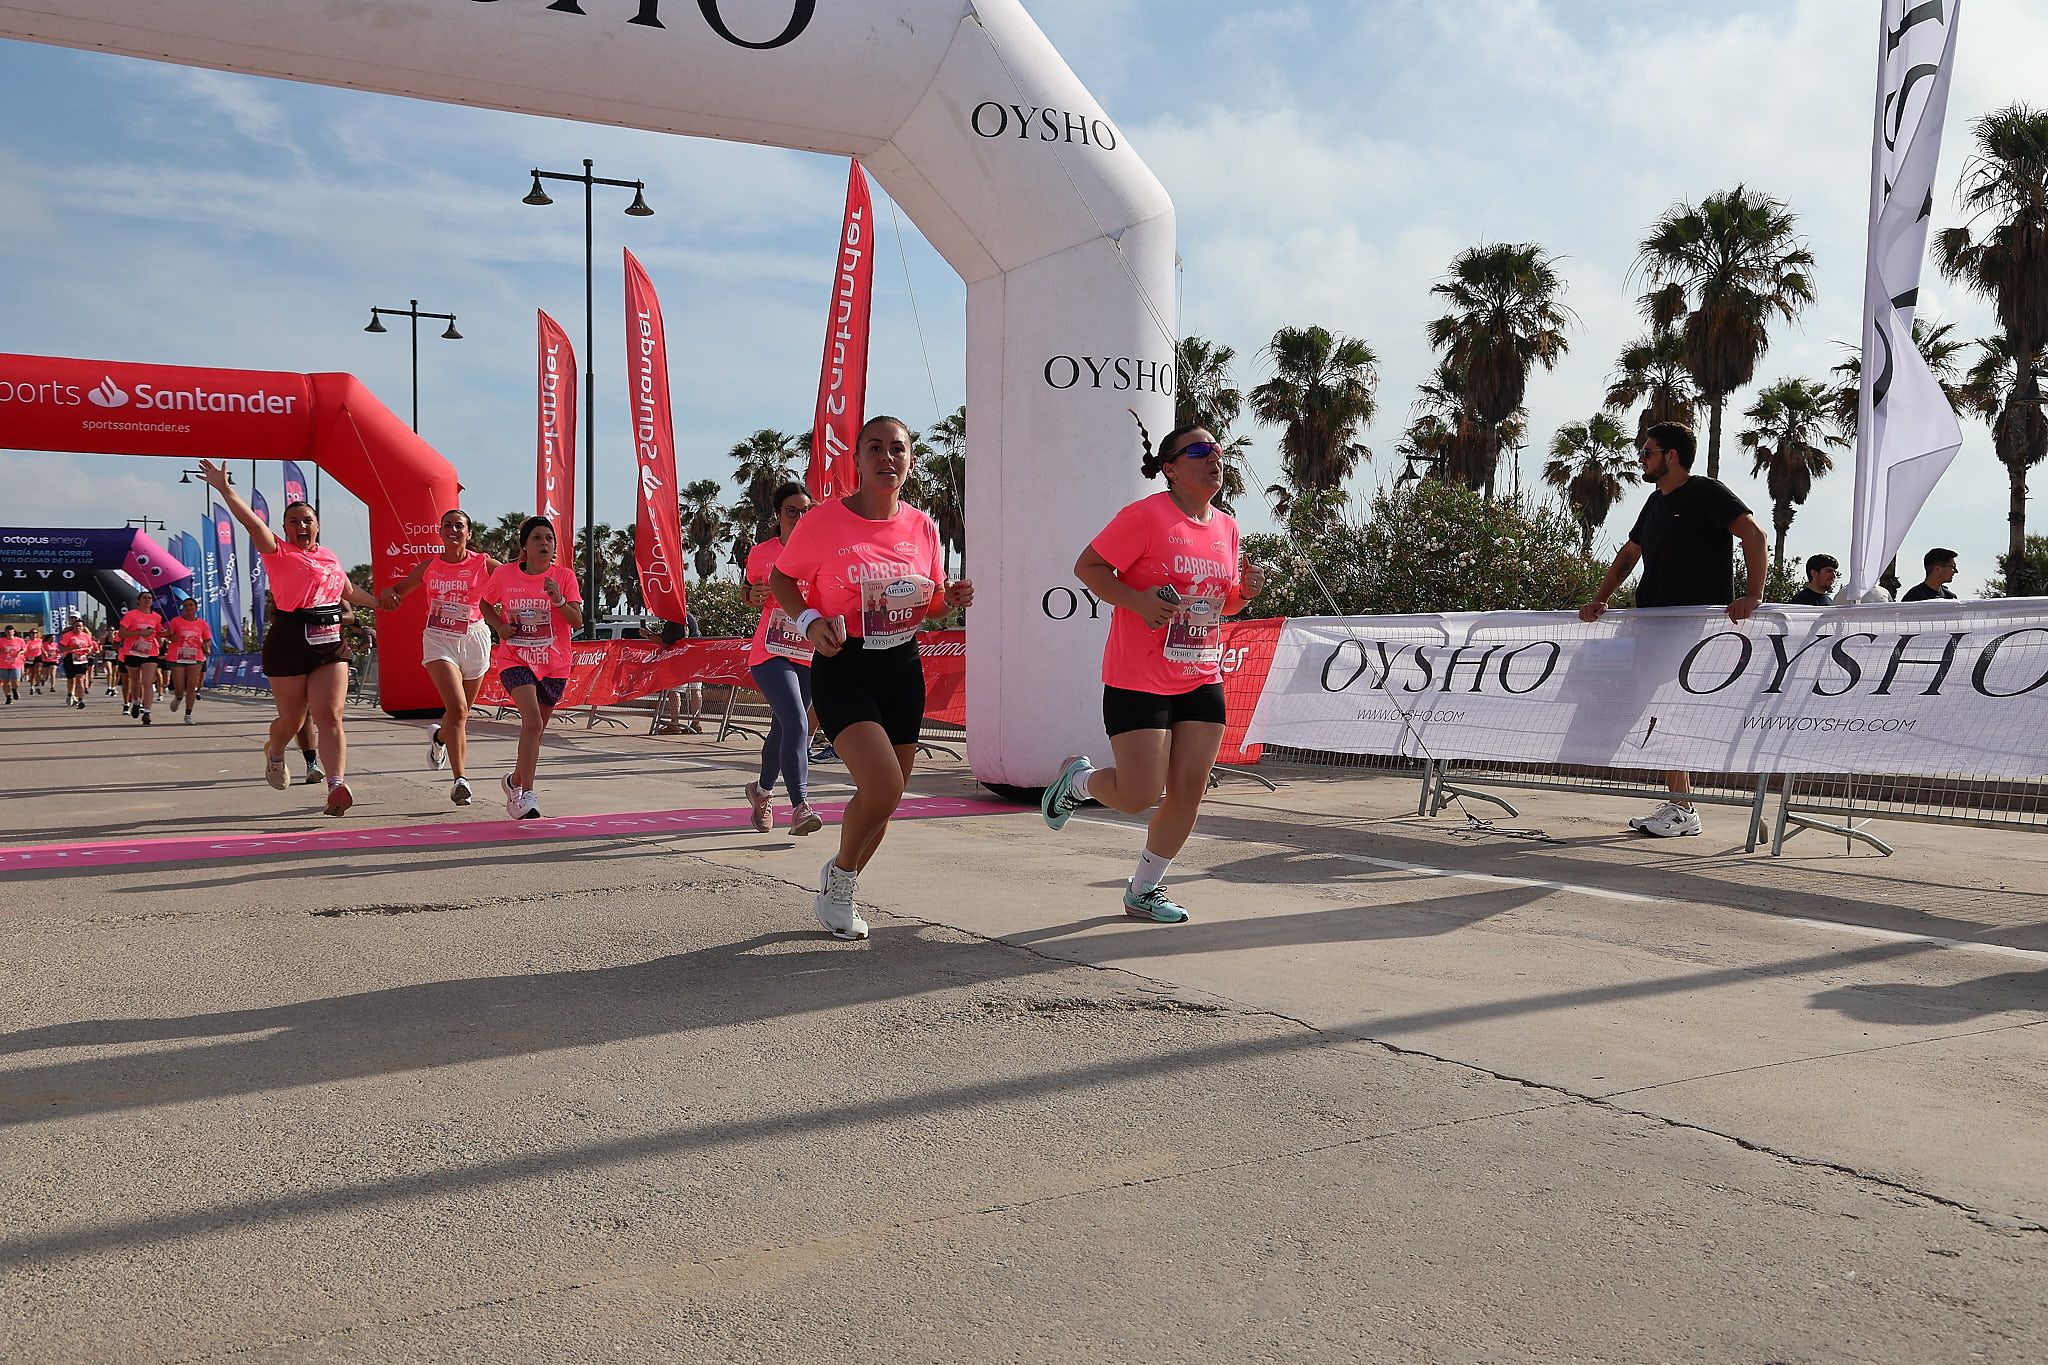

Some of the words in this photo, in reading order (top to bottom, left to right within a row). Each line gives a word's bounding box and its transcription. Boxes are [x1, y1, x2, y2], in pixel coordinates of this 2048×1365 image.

[970, 101, 1117, 151] OYSHO
[1043, 354, 1173, 398] OYSHO
[135, 383, 297, 415] Santander
[82, 419, 191, 433] sportssantander.es
[838, 545, 871, 556] OYSHO
[0, 569, 75, 579] LVO
[847, 562, 917, 584] CARRERA
[1174, 555, 1229, 580] CARRERA
[430, 579, 468, 591] CARRERA
[509, 599, 552, 611] CARRERA
[441, 617, 456, 625] 016
[889, 608, 912, 622] 016
[783, 631, 802, 642] 016
[1188, 625, 1208, 637] 016
[1321, 639, 1561, 694] OYSHO
[1678, 627, 2048, 698] OYSHO
[1356, 709, 1466, 723] WWW.OYSHO.COM
[1742, 715, 1918, 733] WWW.OYSHO.COM
[517, 813, 733, 831] OYSHO
[209, 829, 461, 850] OYSHO
